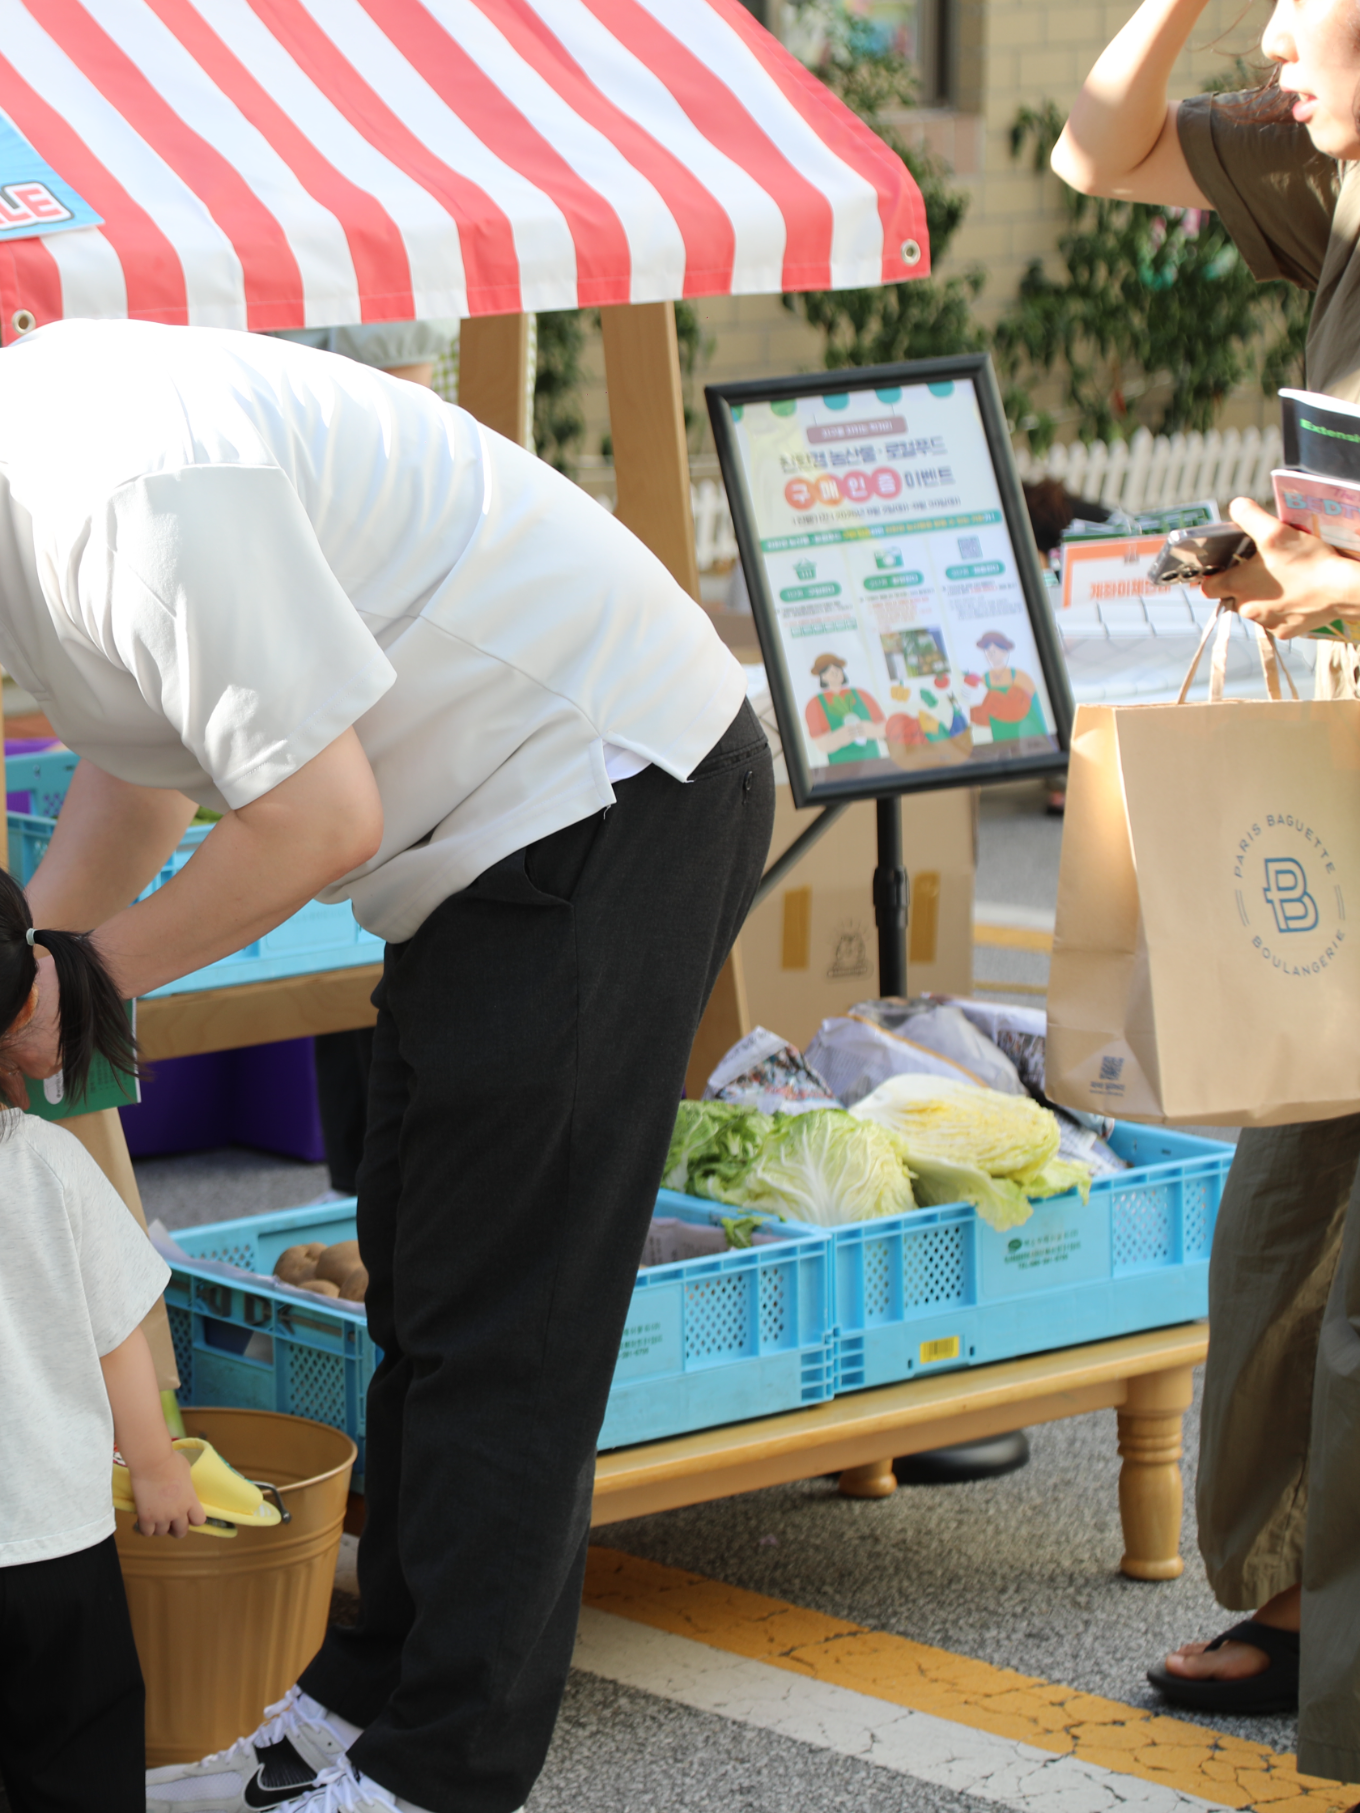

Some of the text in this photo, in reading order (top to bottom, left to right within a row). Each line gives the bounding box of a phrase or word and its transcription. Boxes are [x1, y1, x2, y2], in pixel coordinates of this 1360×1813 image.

[883, 435, 948, 460] 로컬푸드
[789, 465, 956, 504] 구매인증 이벤트
[1284, 492, 1360, 520] BEDT
[1234, 814, 1336, 878] PARIS BAGUETTE
[1251, 929, 1346, 977] BOULANGERIE
